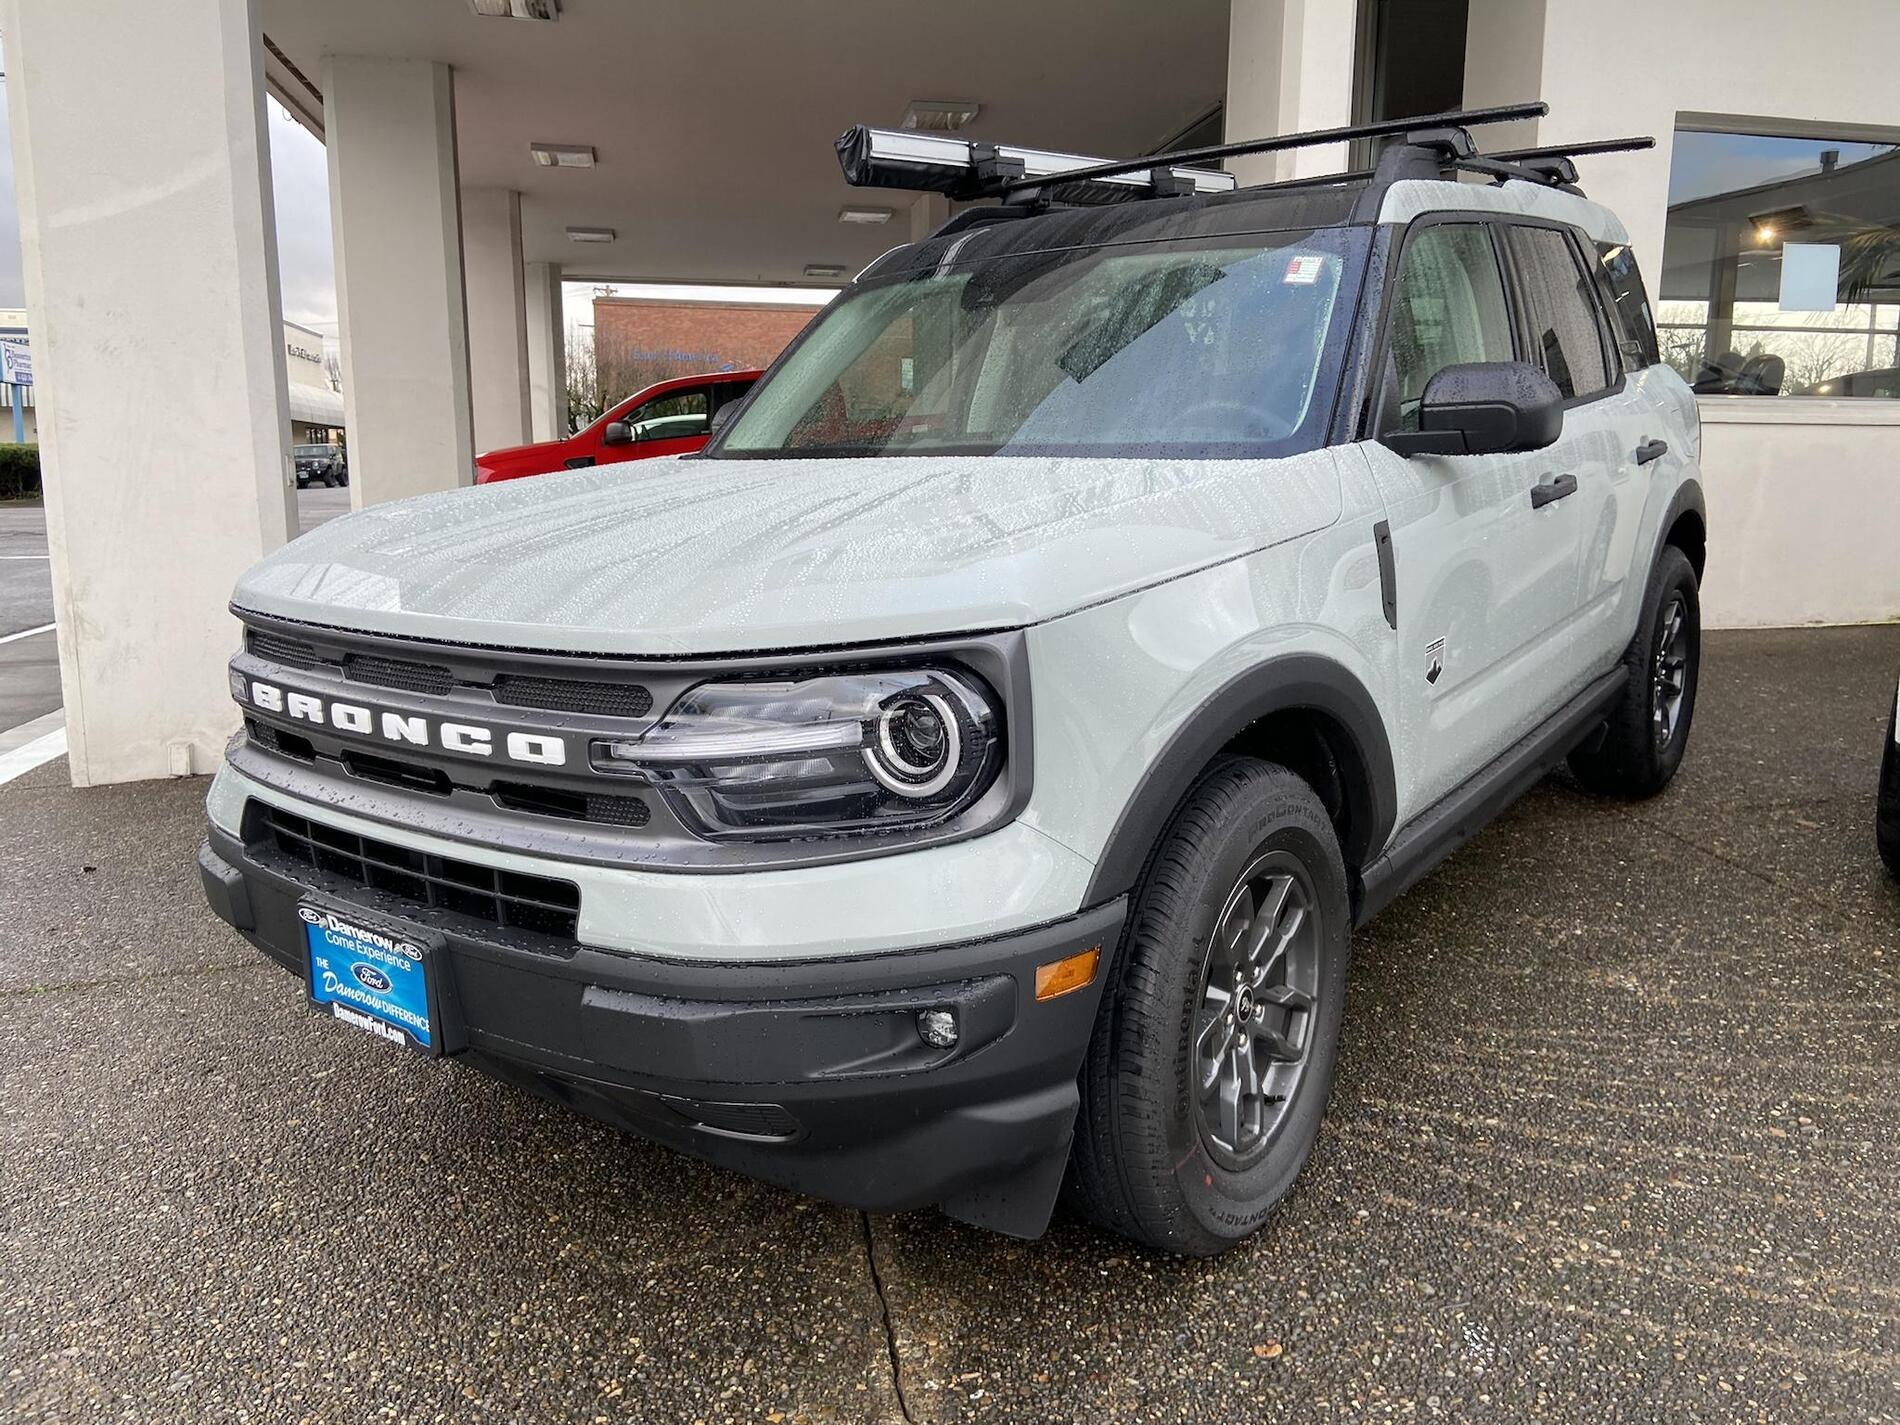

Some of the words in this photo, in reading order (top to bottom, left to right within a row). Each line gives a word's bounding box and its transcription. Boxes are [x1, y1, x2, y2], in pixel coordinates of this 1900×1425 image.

[252, 681, 566, 766] BRONCO
[325, 931, 355, 950] Come
[356, 942, 411, 972] Experience
[326, 914, 393, 951] Damerow
[316, 957, 329, 969] THE
[323, 971, 383, 1009] Damerow
[382, 1002, 430, 1033] DIFFERENCE
